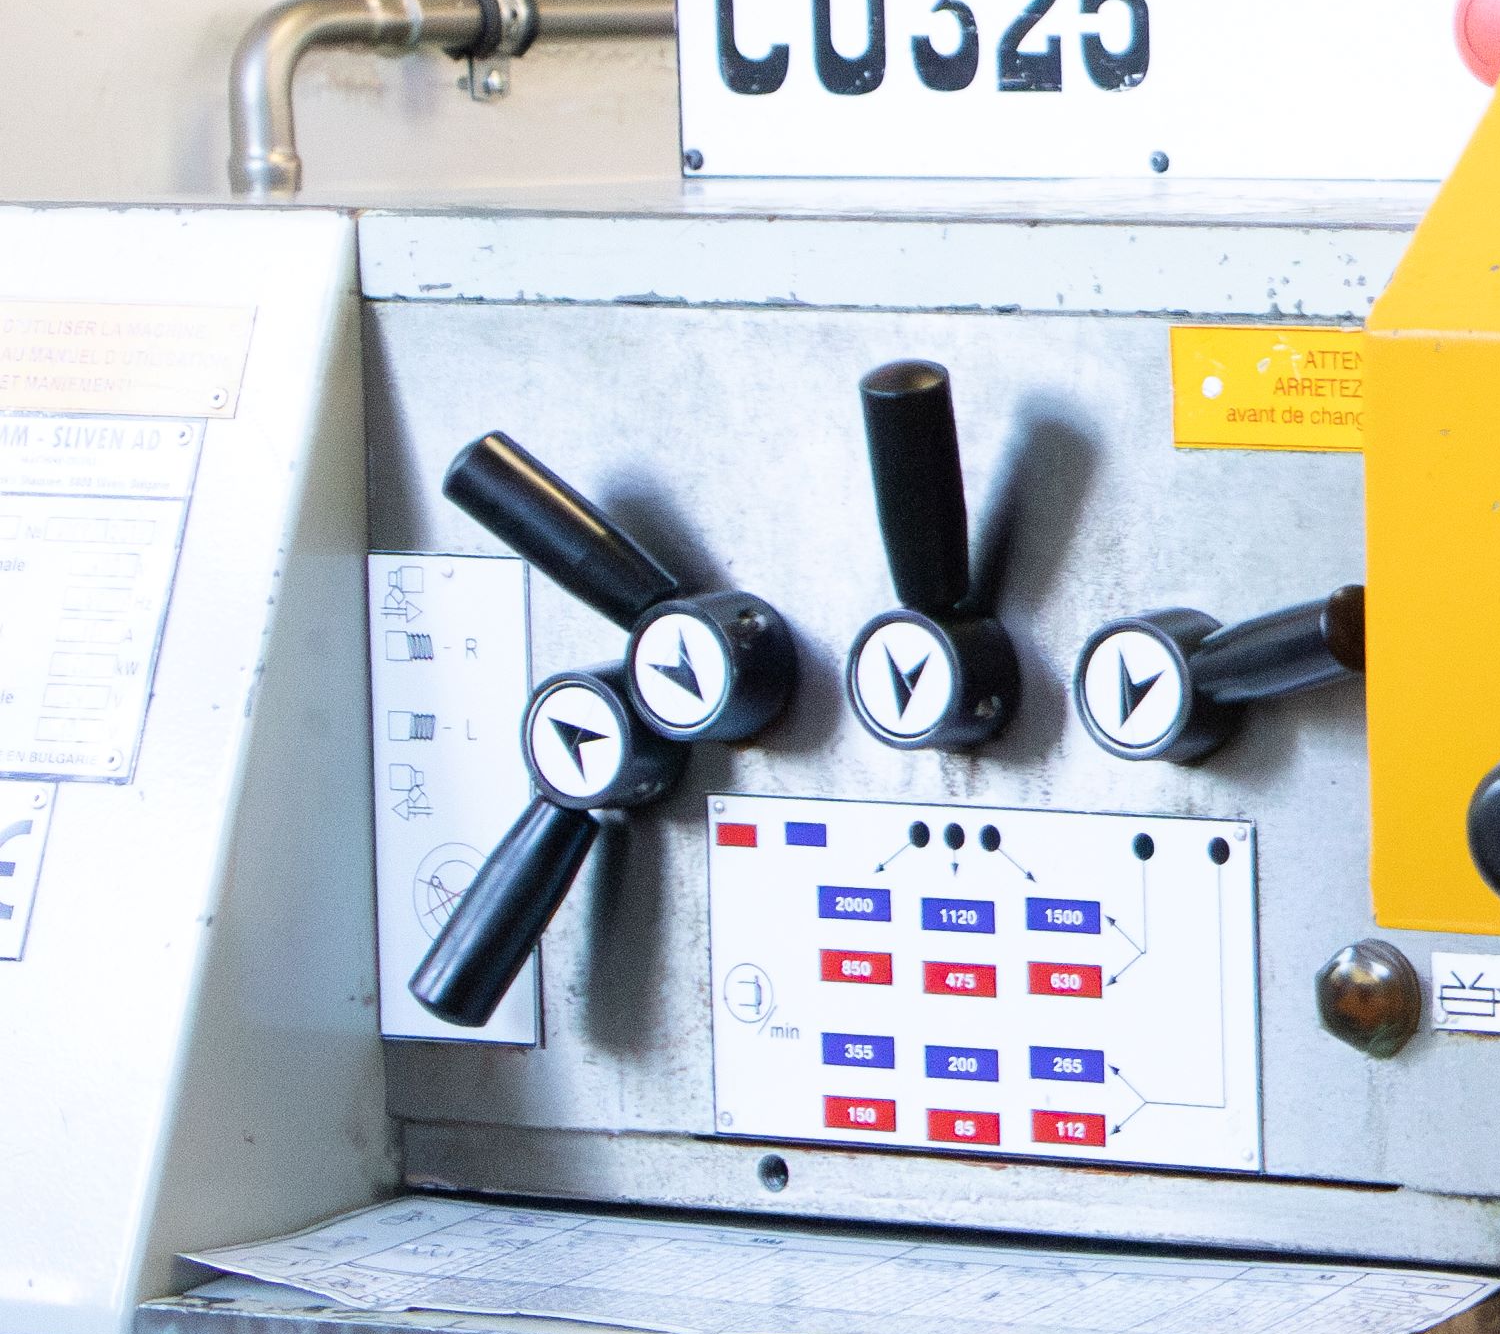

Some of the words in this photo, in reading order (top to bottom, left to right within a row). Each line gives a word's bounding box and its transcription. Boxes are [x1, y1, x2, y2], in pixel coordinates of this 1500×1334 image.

[1273, 376, 1364, 398] ARRETEZ
[1226, 407, 1276, 423] avant
[1281, 406, 1304, 424] de
[53, 424, 126, 450] SLIVEN
[131, 428, 161, 451] AD
[465, 637, 478, 659] R
[466, 720, 477, 741] L
[29, 751, 97, 766] BULGARIE
[835, 896, 874, 914] 2000
[939, 909, 978, 926] 1120
[1045, 908, 1084, 927] 1500
[841, 960, 871, 978] 850
[945, 973, 976, 990] 475
[1050, 973, 1081, 990] 630
[770, 1022, 800, 1040] min
[844, 1043, 874, 1060] 355
[947, 1056, 978, 1073] 200
[1053, 1056, 1083, 1074] 265
[847, 1106, 877, 1124] 150
[954, 1120, 976, 1137] 85
[1055, 1120, 1086, 1139] 112
